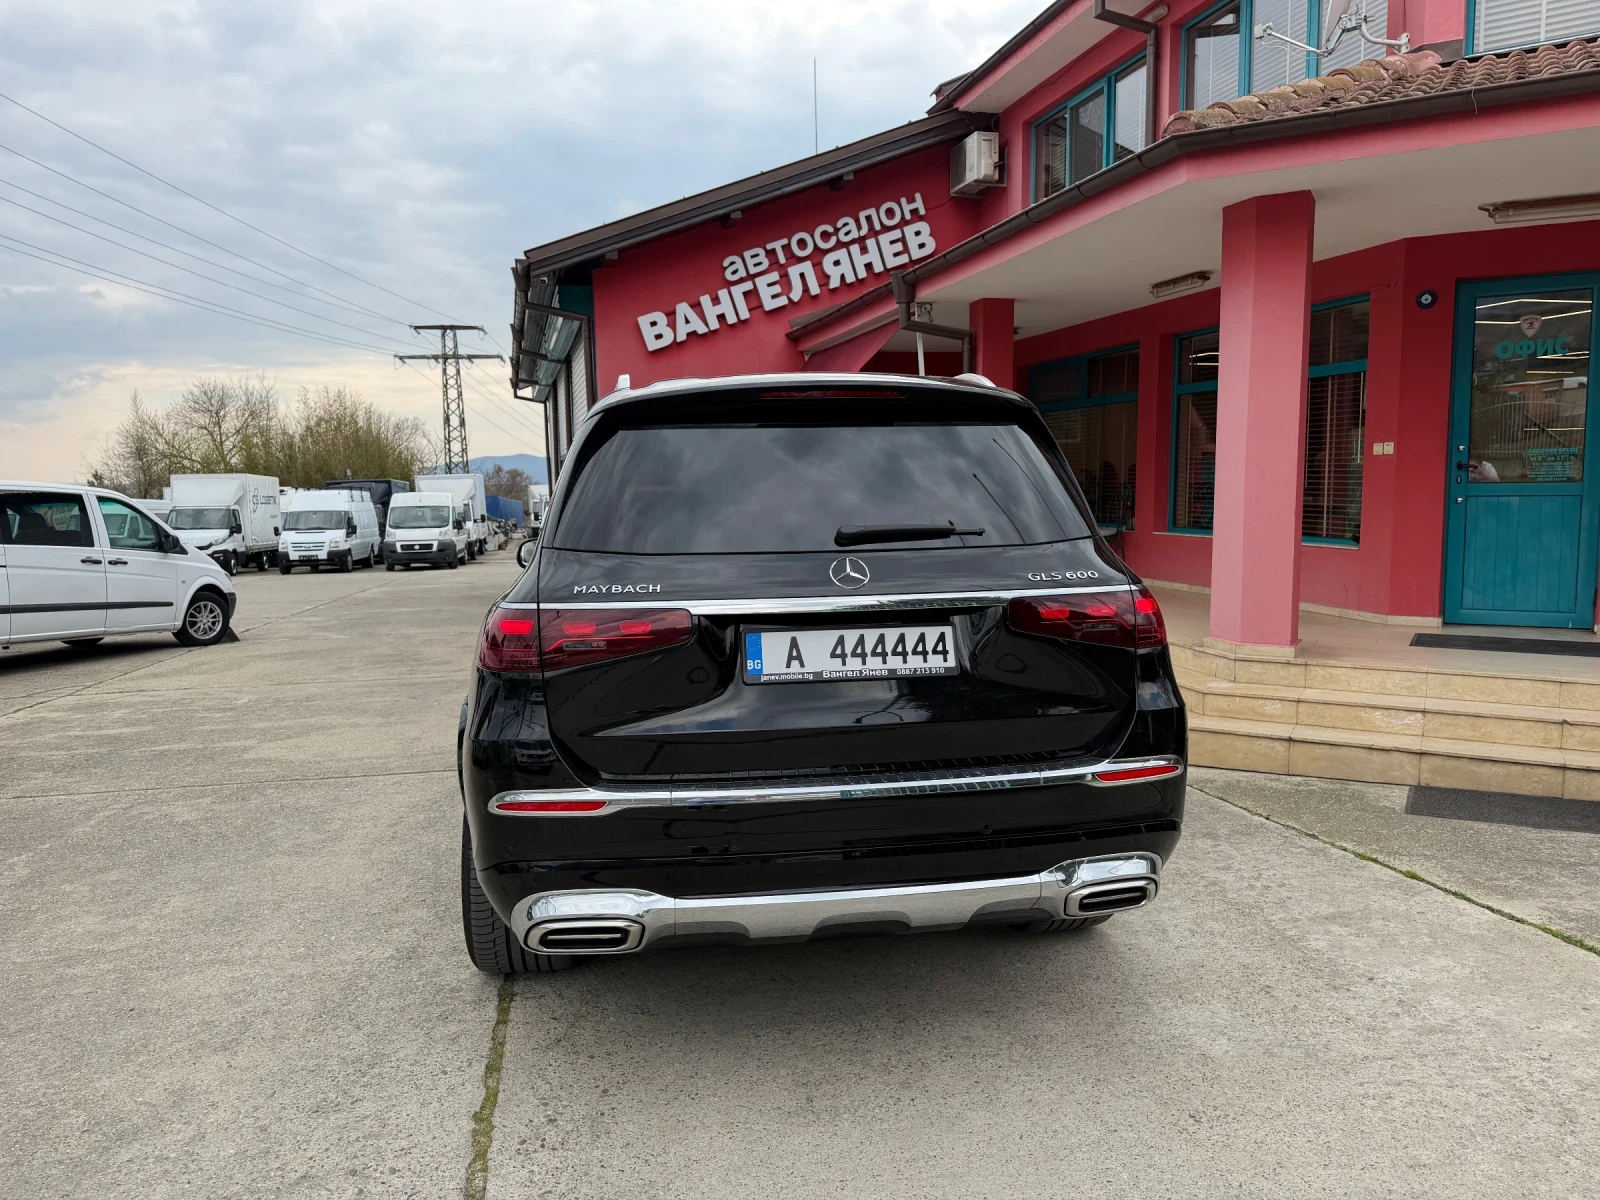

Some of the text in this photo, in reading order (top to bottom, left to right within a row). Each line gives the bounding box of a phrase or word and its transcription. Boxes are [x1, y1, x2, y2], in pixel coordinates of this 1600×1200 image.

[722, 192, 926, 282] автосалон
[637, 221, 936, 352] ВАНГЕЛ ЯНЕВ
[1495, 335, 1570, 360] ОФИС
[1028, 570, 1098, 581] GLS 600
[573, 584, 661, 594] MAYBACH
[785, 631, 949, 669] A 444444
[747, 659, 762, 670] BG
[761, 672, 813, 682] janev.mobile.bg
[822, 668, 888, 678] Вангел Янев
